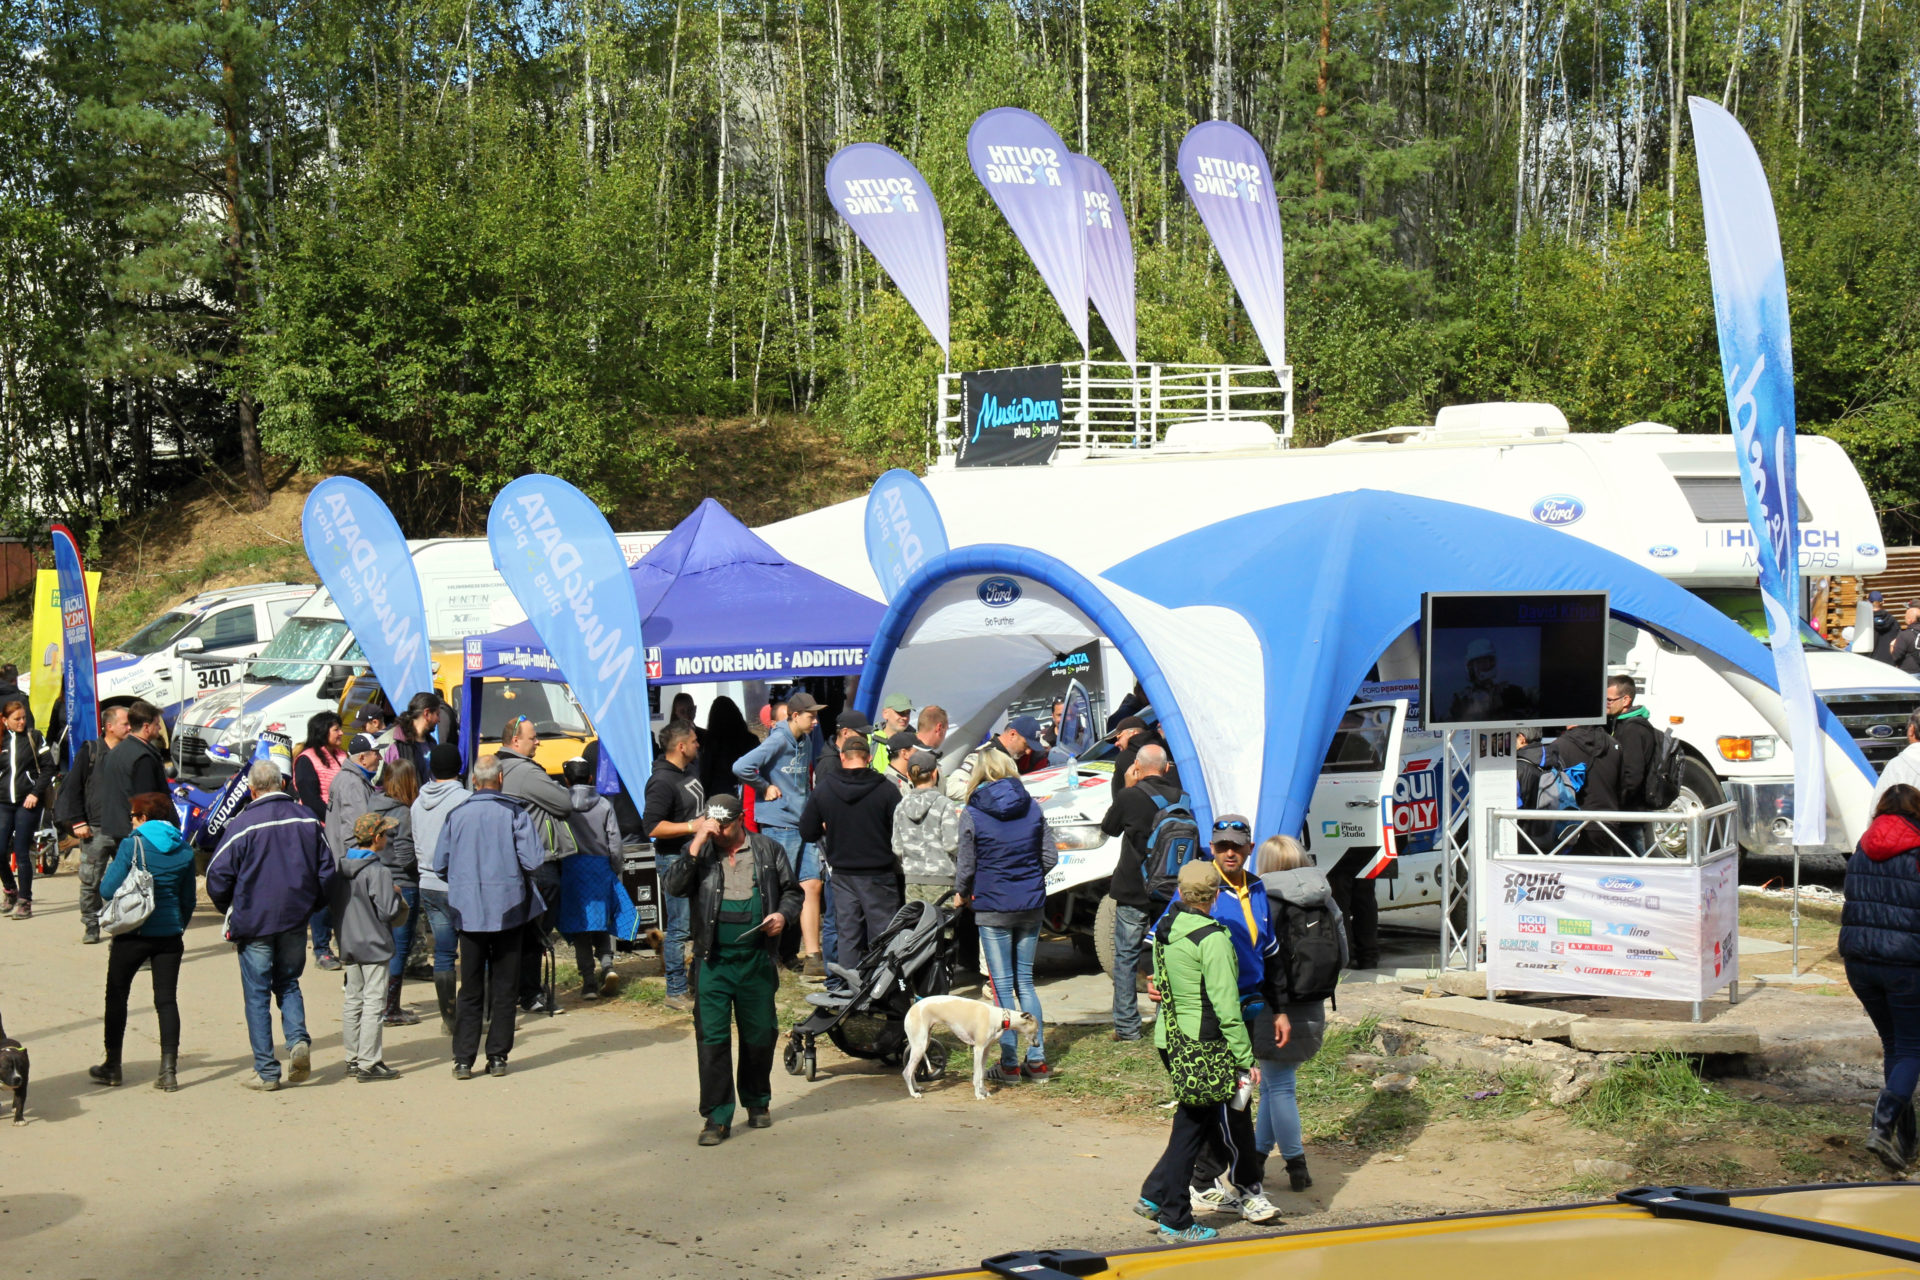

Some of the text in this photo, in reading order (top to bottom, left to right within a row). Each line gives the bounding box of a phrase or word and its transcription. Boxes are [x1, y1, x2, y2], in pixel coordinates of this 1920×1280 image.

[1013, 422, 1059, 438] plug play
[1540, 499, 1575, 521] Ford
[1653, 547, 1675, 556] Ford
[986, 582, 1012, 602] Ford
[1518, 602, 1556, 618] David
[467, 641, 481, 654] LIQUI
[467, 656, 481, 669] MOLY
[675, 648, 863, 675] MOTORENÖLE ADDITIVE
[1052, 664, 1090, 676] plug play
[197, 669, 231, 689] 340
[1362, 686, 1380, 694] FORD
[207, 775, 249, 836] GAULOISES
[1503, 872, 1562, 888] SOUTH
[1606, 877, 1635, 889] Ford
[1519, 915, 1545, 924] LIQUI
[1558, 919, 1591, 928] MANN
[1519, 924, 1546, 933] MOLY
[1558, 926, 1591, 935] FILTER
